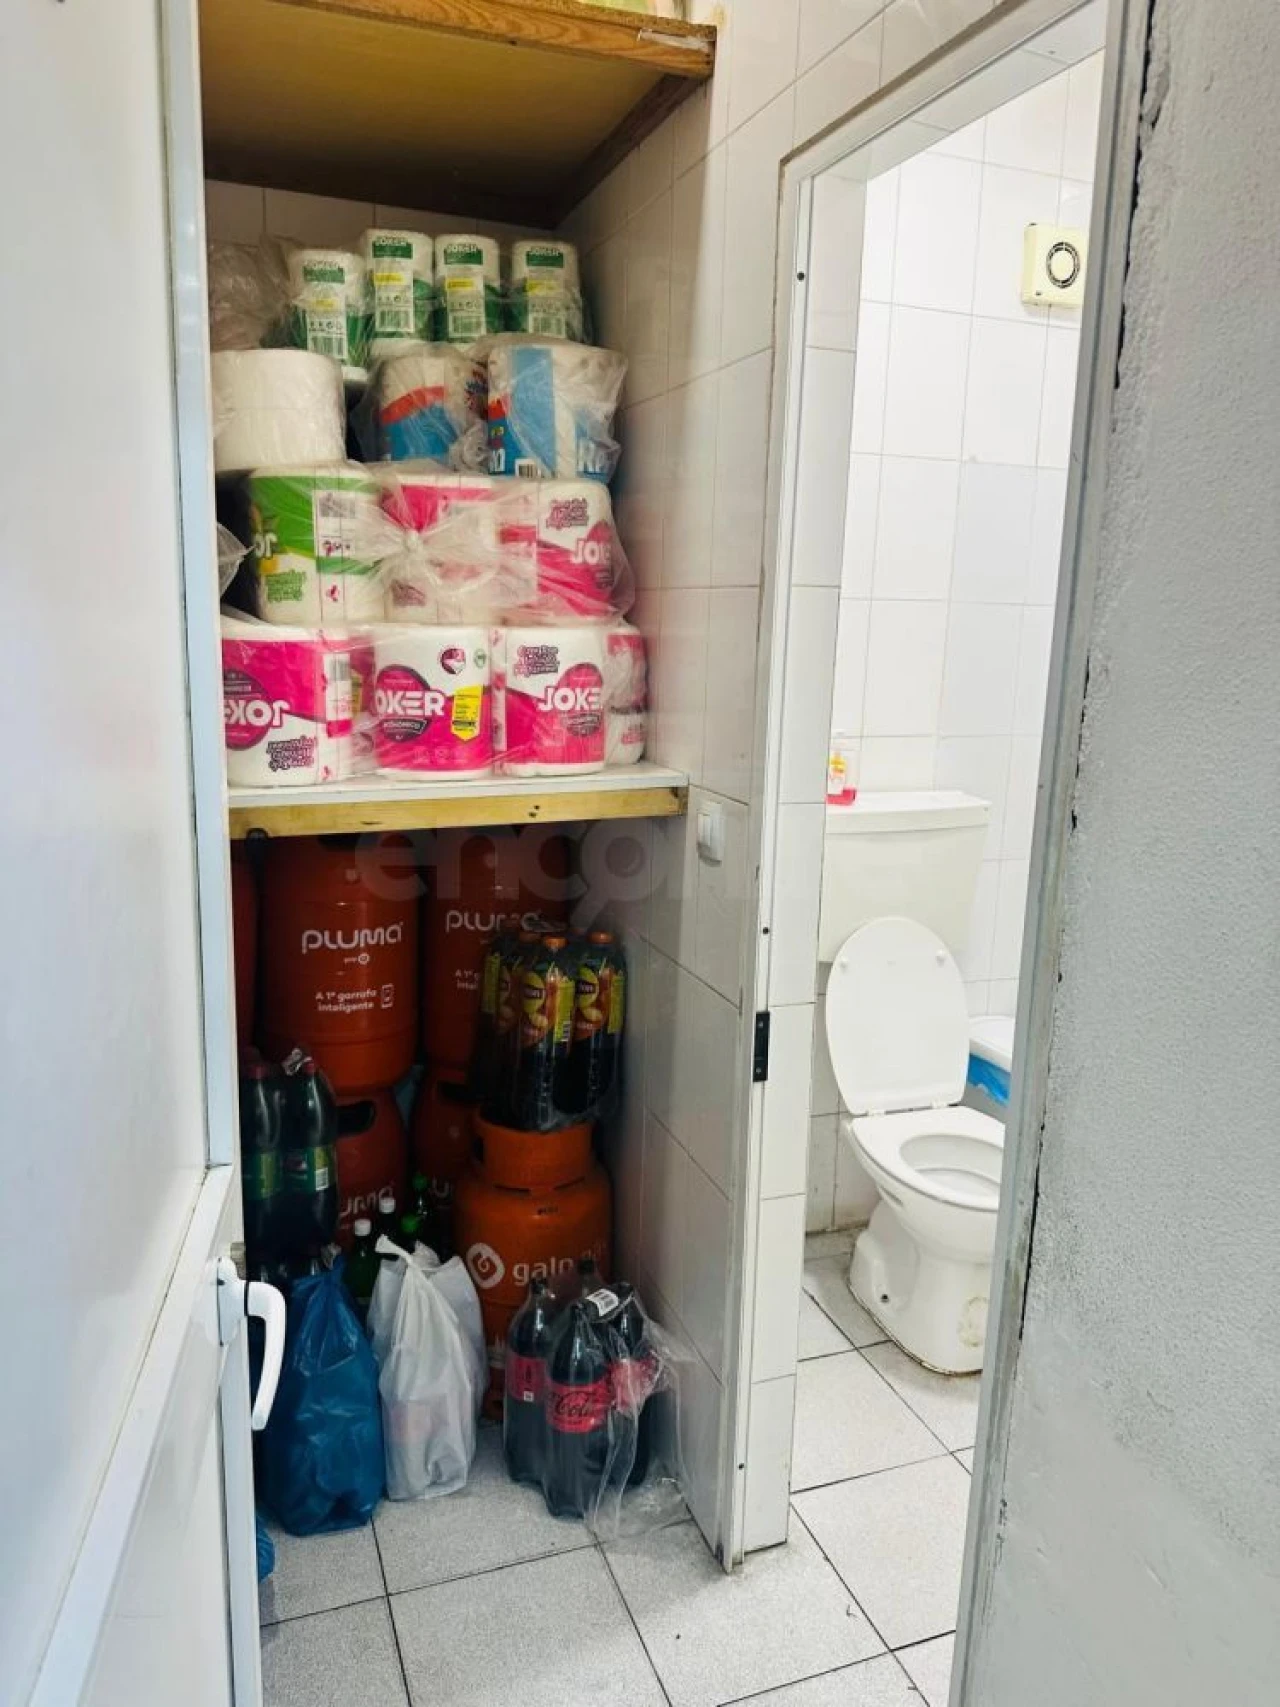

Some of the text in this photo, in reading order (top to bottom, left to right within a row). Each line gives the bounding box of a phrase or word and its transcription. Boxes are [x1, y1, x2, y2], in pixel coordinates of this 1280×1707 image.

[375, 689, 445, 717] OKER
[537, 686, 604, 712] JOKE
[337, 988, 378, 1004] garrafa
[317, 1000, 375, 1014] inteligente
